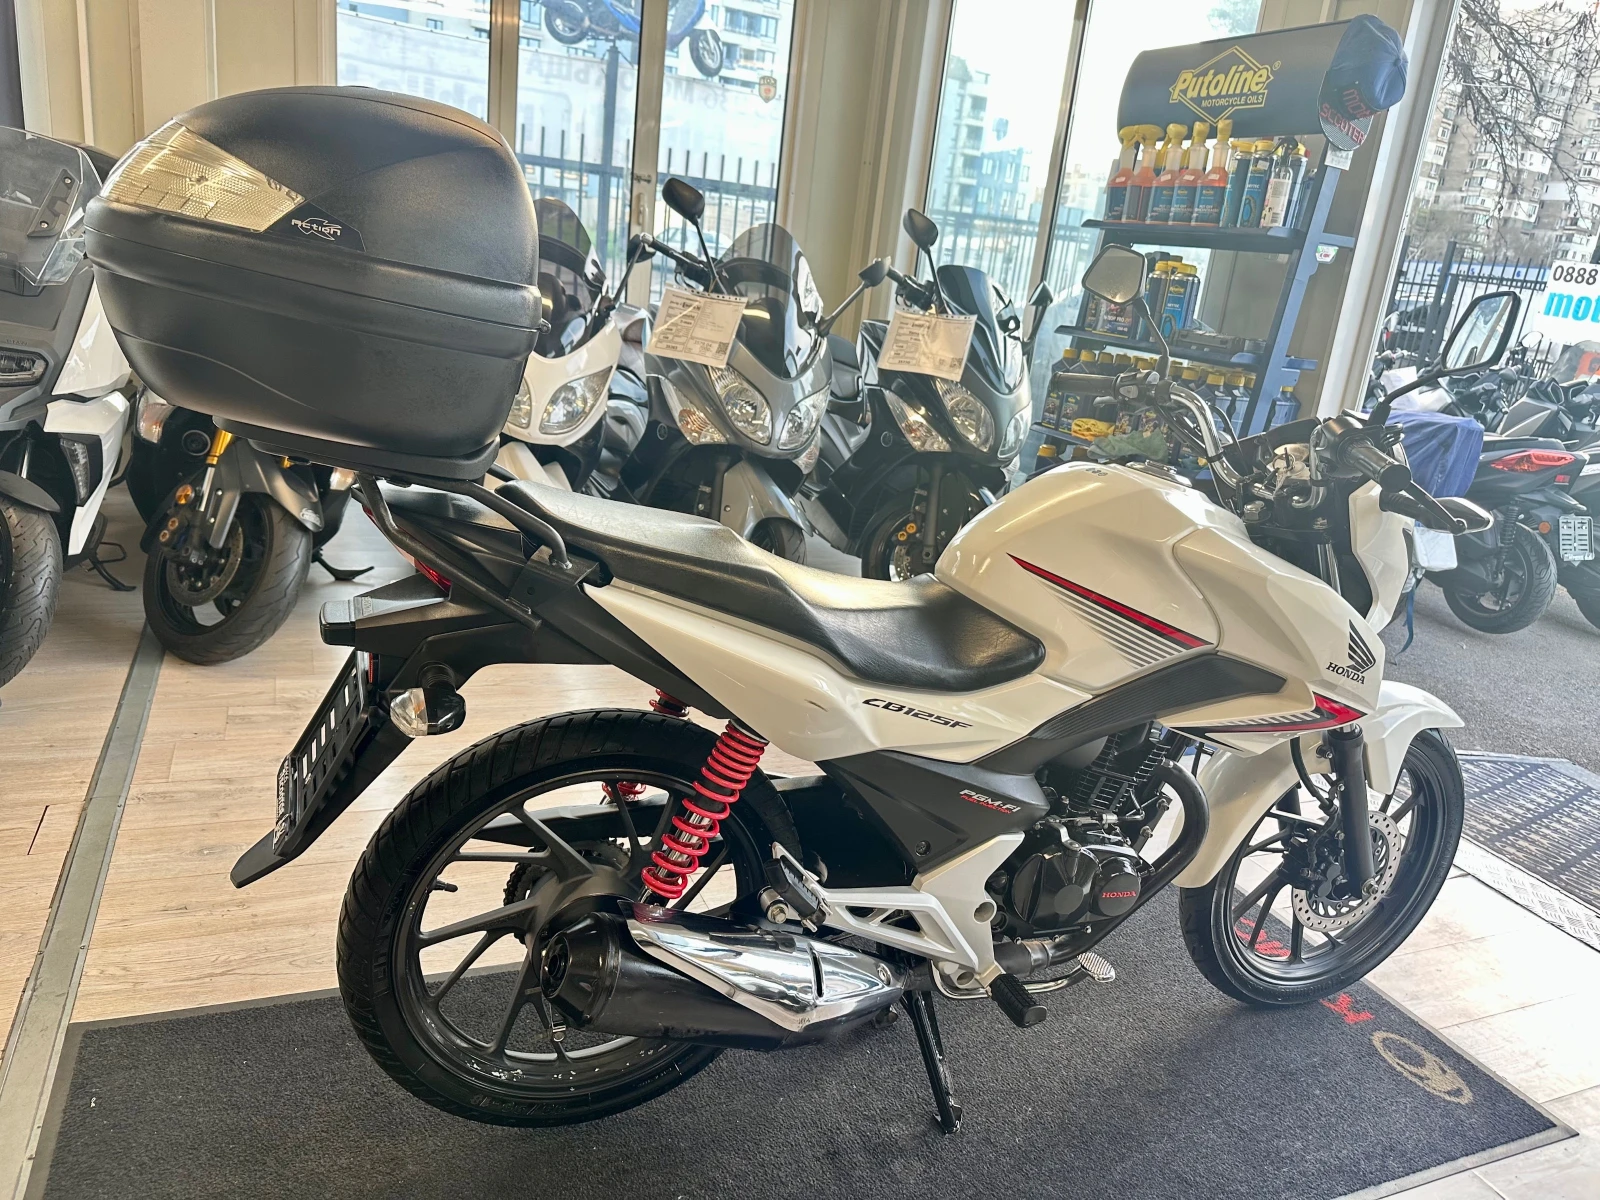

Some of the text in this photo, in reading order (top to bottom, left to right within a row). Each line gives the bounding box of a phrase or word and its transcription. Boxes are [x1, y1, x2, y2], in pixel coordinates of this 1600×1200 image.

[1173, 65, 1269, 100] Putoline
[1201, 95, 1263, 108] MOTORCYCLE OILS
[1552, 265, 1599, 286] 0888
[1326, 662, 1365, 684] HONDA
[862, 698, 973, 728] CB125F
